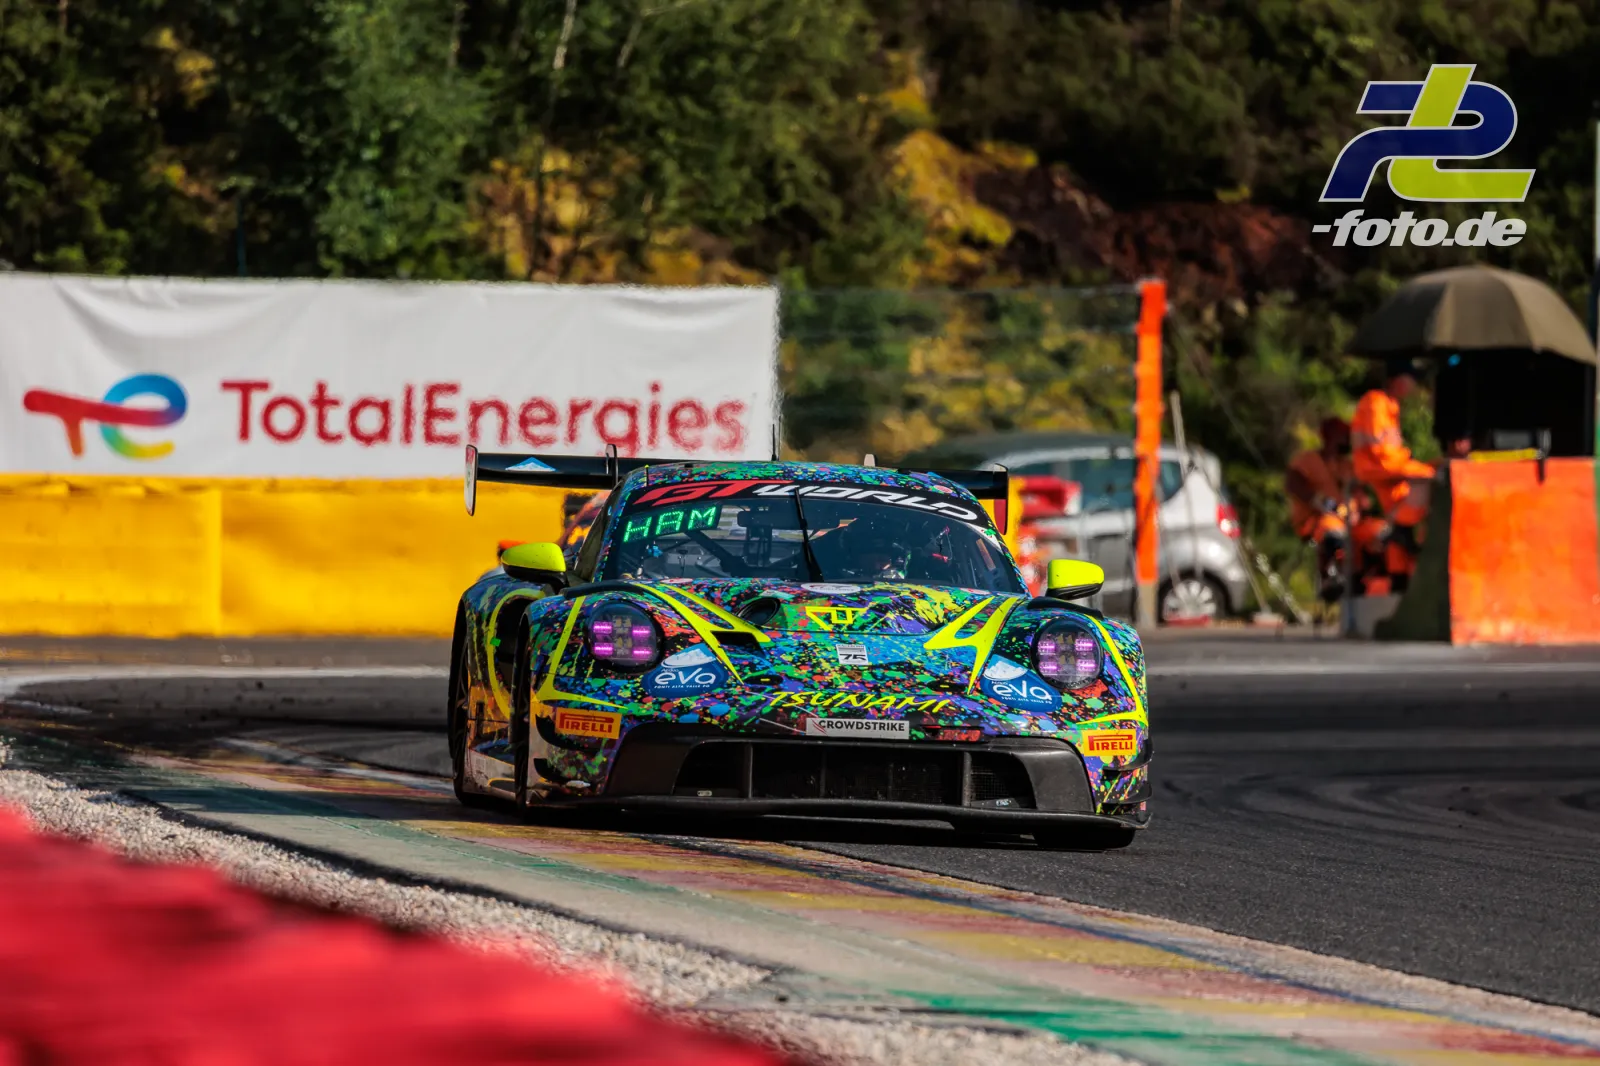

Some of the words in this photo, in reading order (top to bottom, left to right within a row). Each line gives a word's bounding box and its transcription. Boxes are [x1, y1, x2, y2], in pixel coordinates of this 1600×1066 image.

[220, 380, 746, 458] TotalEnergies
[632, 480, 795, 507] GT
[752, 484, 978, 521] WORLD
[623, 506, 717, 543] HAM
[770, 691, 951, 712] TSUNAMI
[558, 712, 615, 733] PIRELLI
[818, 719, 905, 732] CROWDSTRIKE
[1088, 734, 1133, 751] PIRELLI
